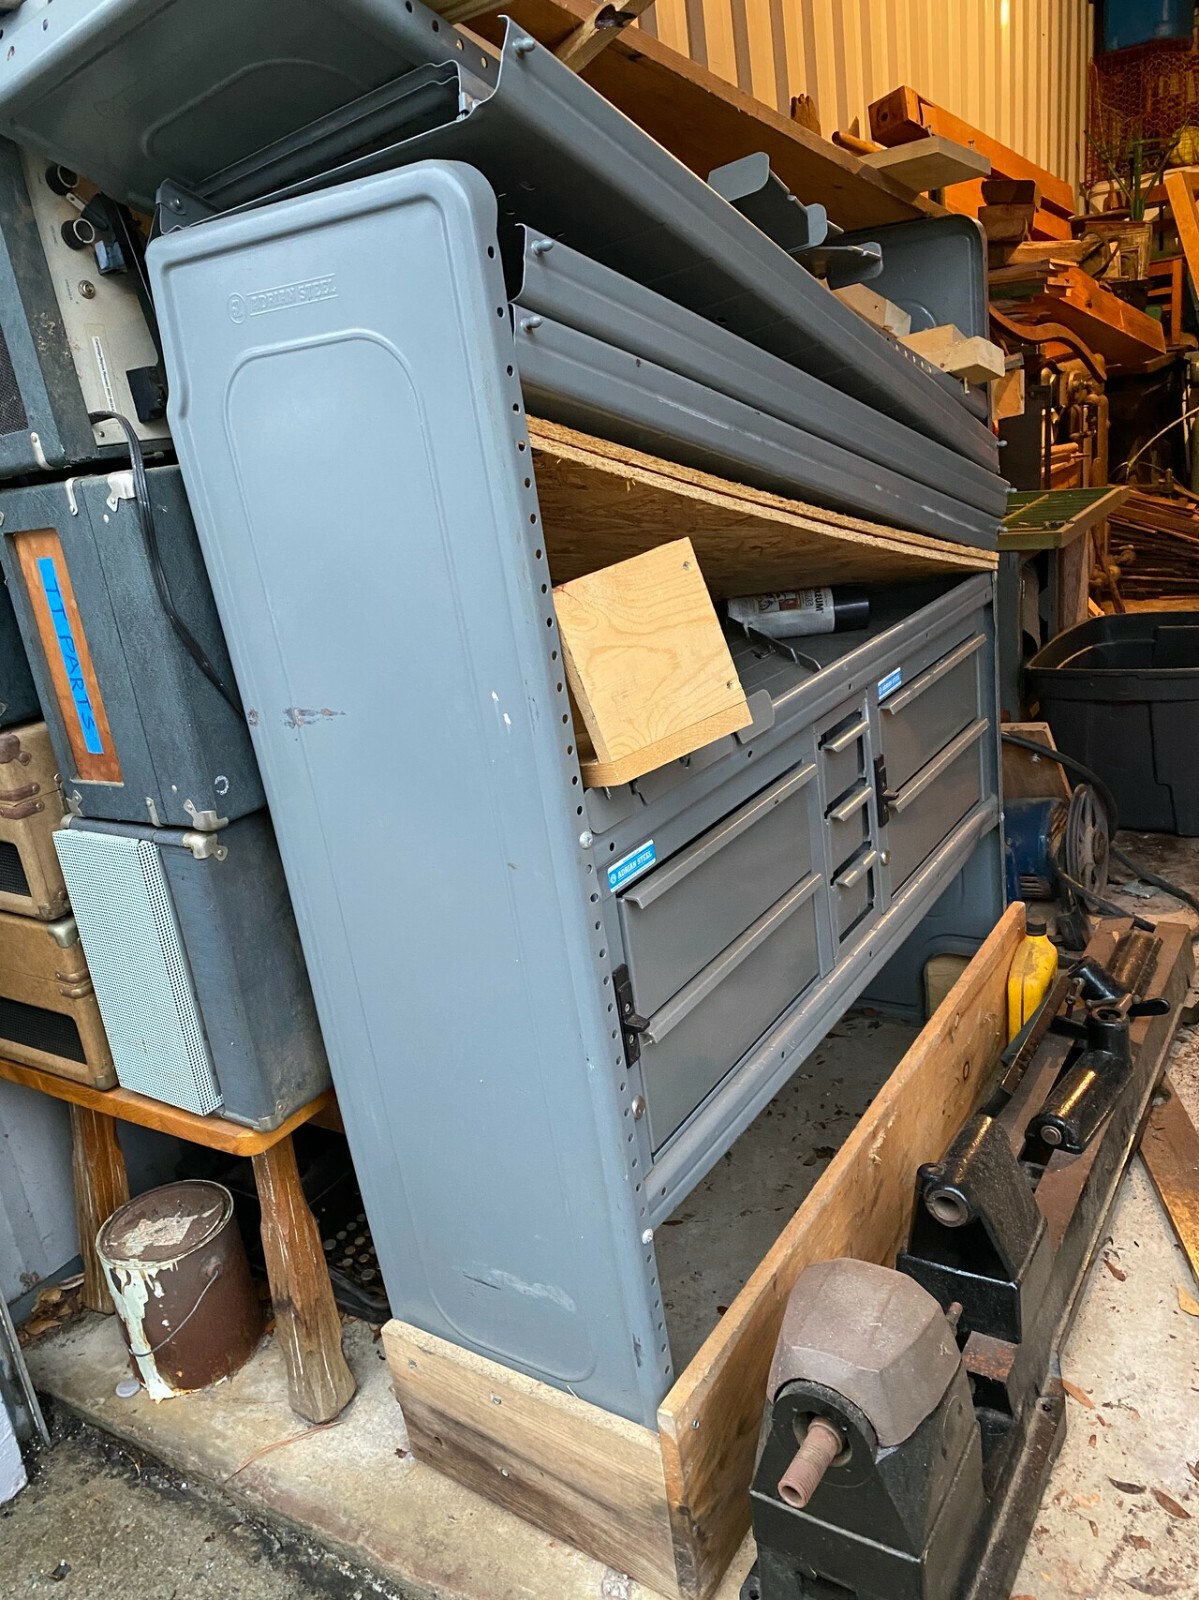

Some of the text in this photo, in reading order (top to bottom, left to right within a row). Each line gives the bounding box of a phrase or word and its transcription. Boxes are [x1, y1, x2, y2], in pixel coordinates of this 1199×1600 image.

[297, 278, 337, 301] STEEL
[45, 577, 97, 732] TT PARTS
